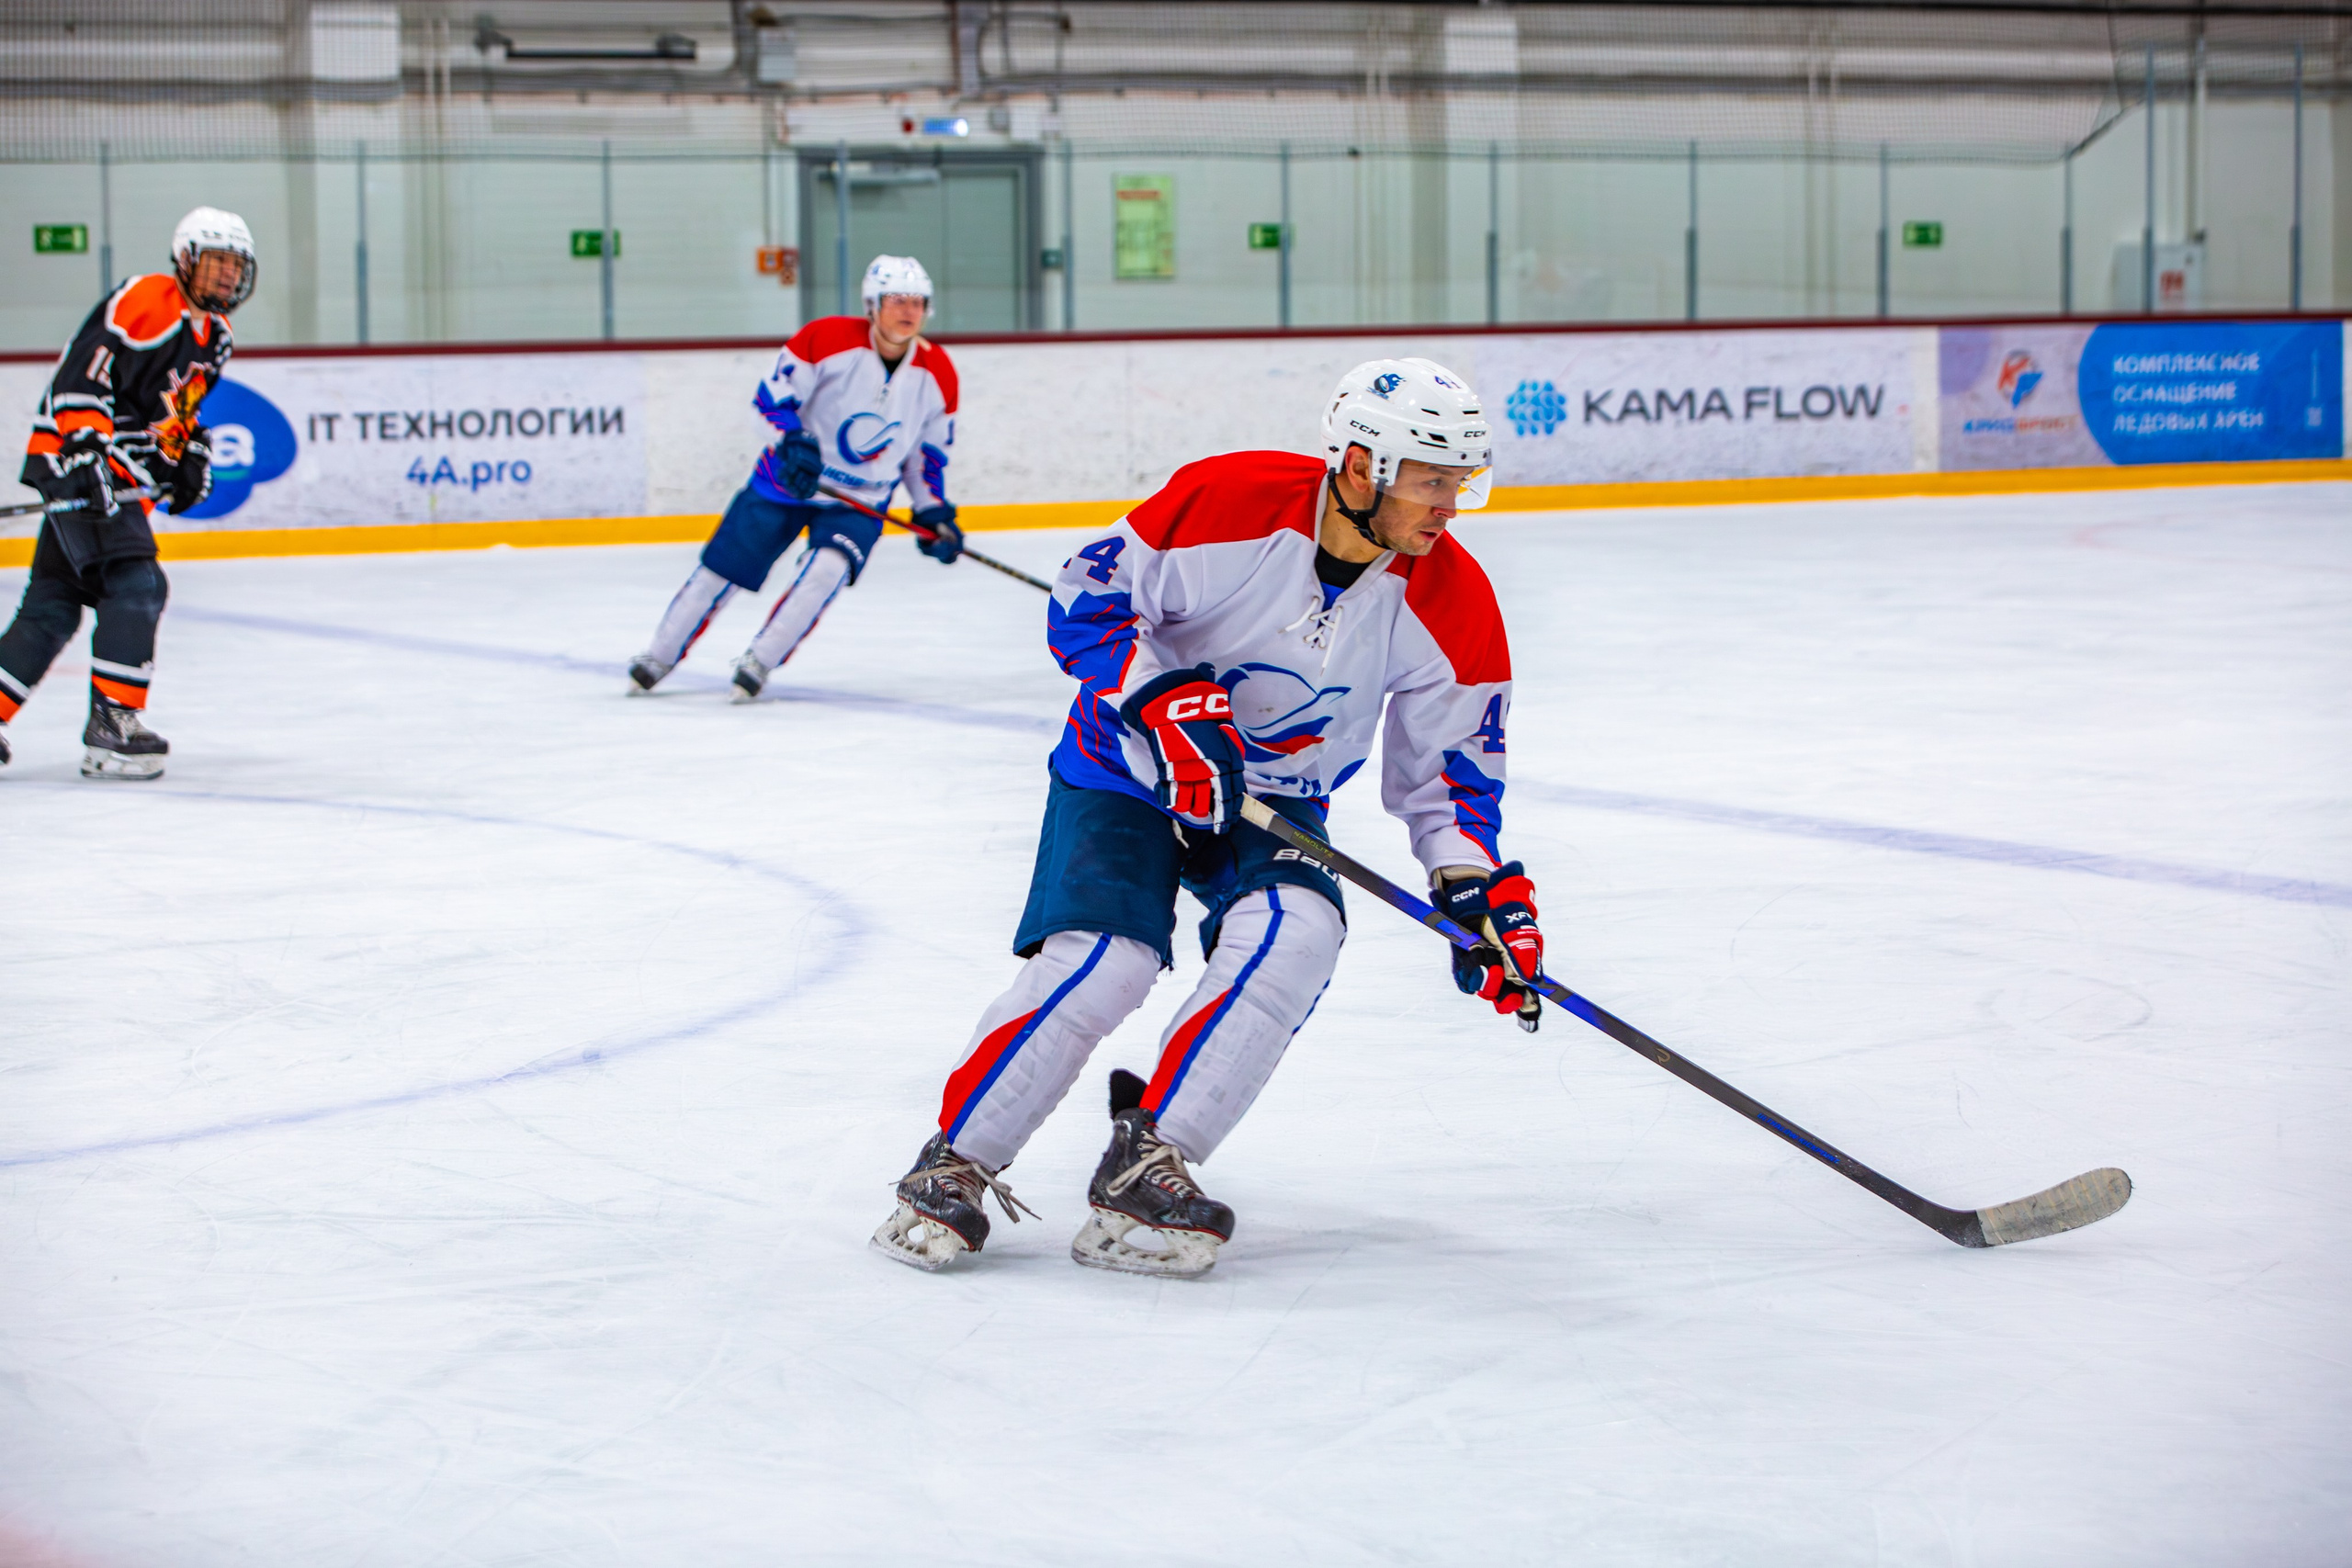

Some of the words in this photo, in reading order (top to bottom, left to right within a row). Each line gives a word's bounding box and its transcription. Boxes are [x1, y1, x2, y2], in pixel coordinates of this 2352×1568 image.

[2113, 353, 2260, 374] КОМПЛЕКСНОЕ
[1584, 387, 1734, 423] KAMA
[1744, 383, 1885, 420] FLOW
[2113, 381, 2237, 405] ОСНАЩЕНИЕ
[354, 407, 625, 441] ТЕХНОЛОГИИ
[1350, 419, 1381, 438] CCM
[406, 457, 532, 491] 4A.pro
[1062, 536, 1126, 585] 4
[1166, 693, 1229, 720] CC
[1470, 693, 1510, 754] 4
[1452, 886, 1479, 903] CCM
